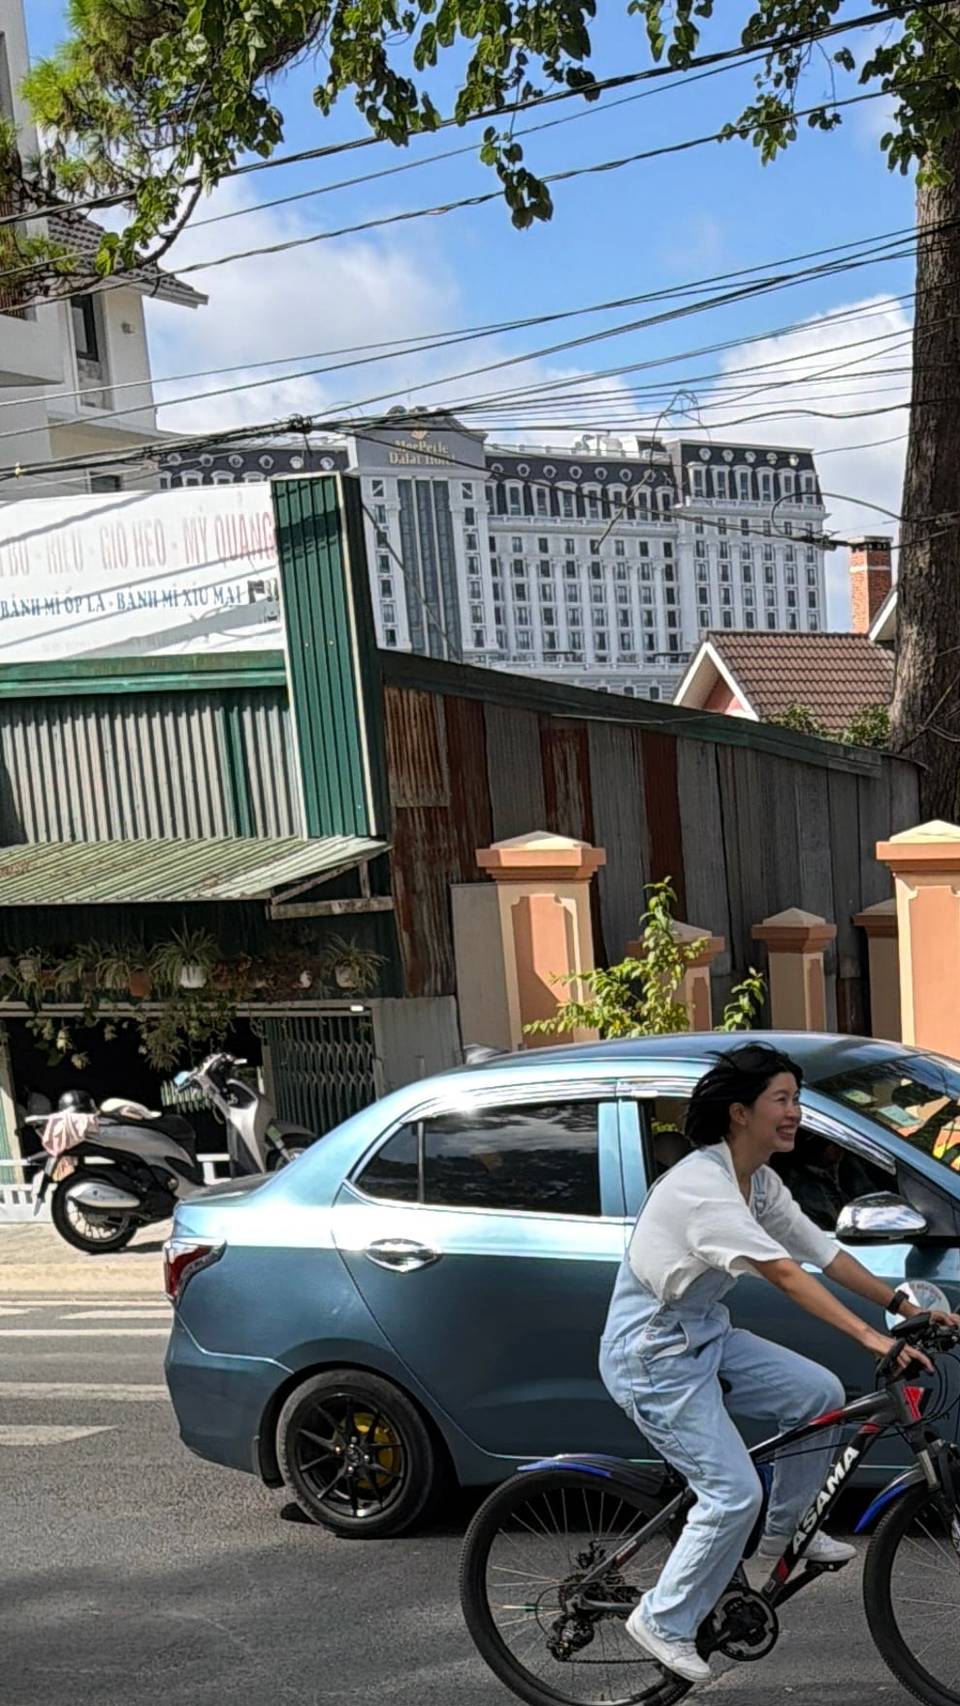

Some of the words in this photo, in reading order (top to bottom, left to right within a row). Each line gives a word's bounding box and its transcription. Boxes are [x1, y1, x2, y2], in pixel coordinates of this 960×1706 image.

[132, 518, 167, 568] HEO
[0, 593, 41, 619] BÁNH
[117, 585, 158, 610] BÁNH
[793, 1446, 860, 1555] ASAMA
